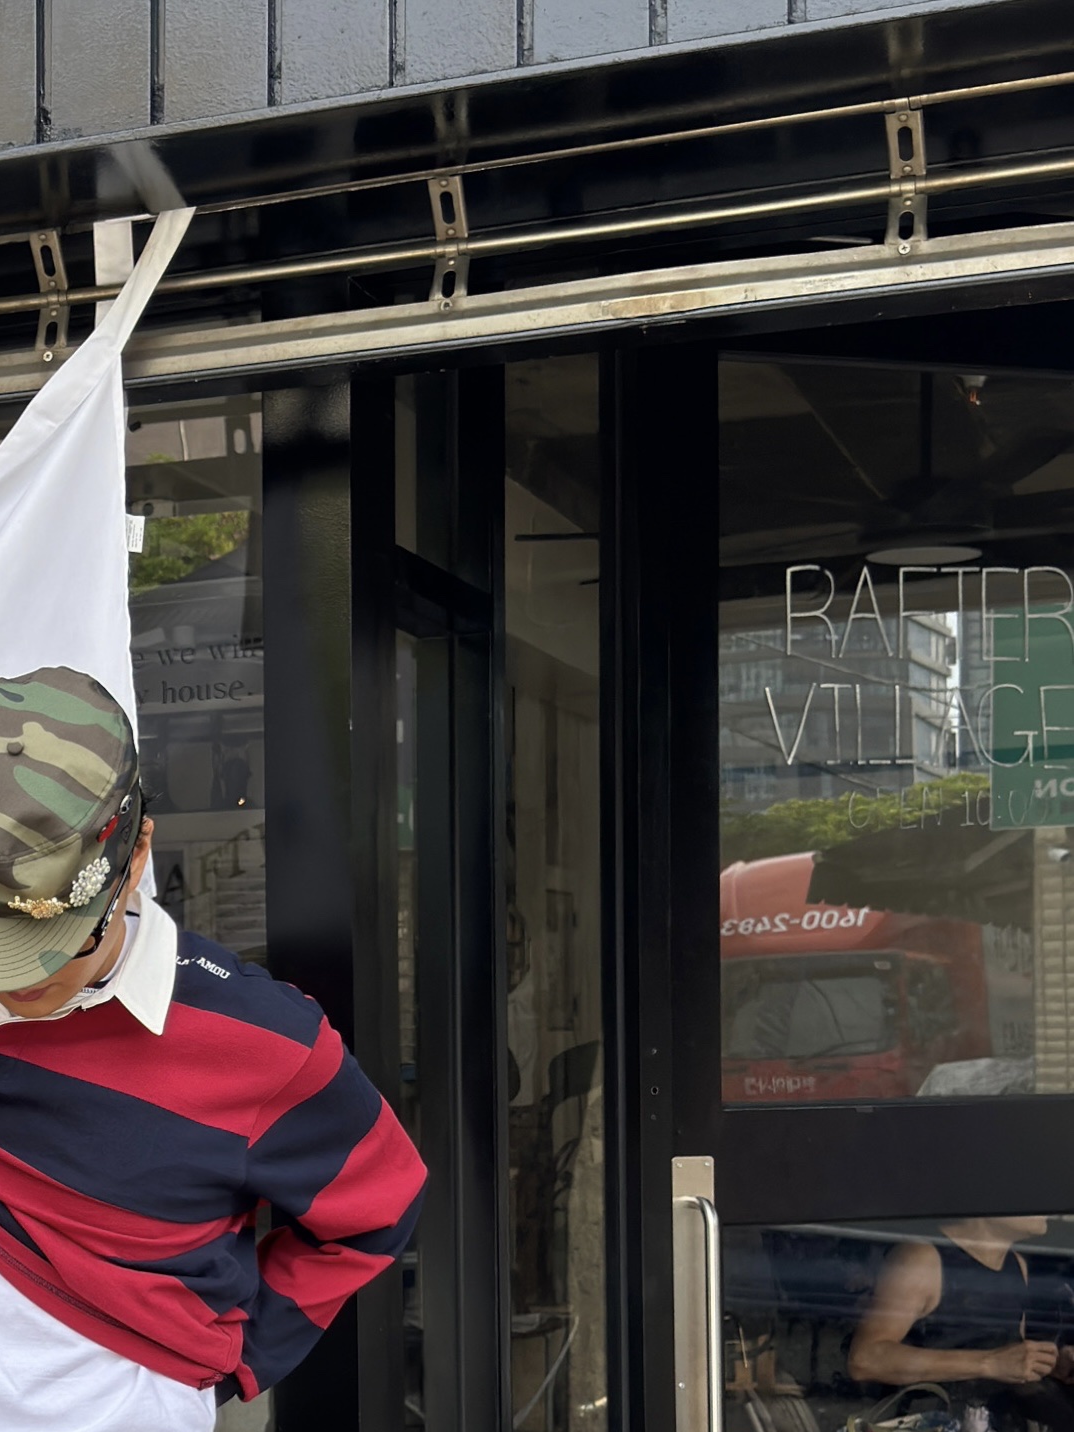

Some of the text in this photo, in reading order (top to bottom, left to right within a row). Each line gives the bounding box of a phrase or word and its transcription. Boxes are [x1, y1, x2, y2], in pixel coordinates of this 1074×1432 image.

[785, 564, 1074, 663] RAFTER
[162, 679, 254, 705] house.
[764, 682, 1074, 769] VILLAGE
